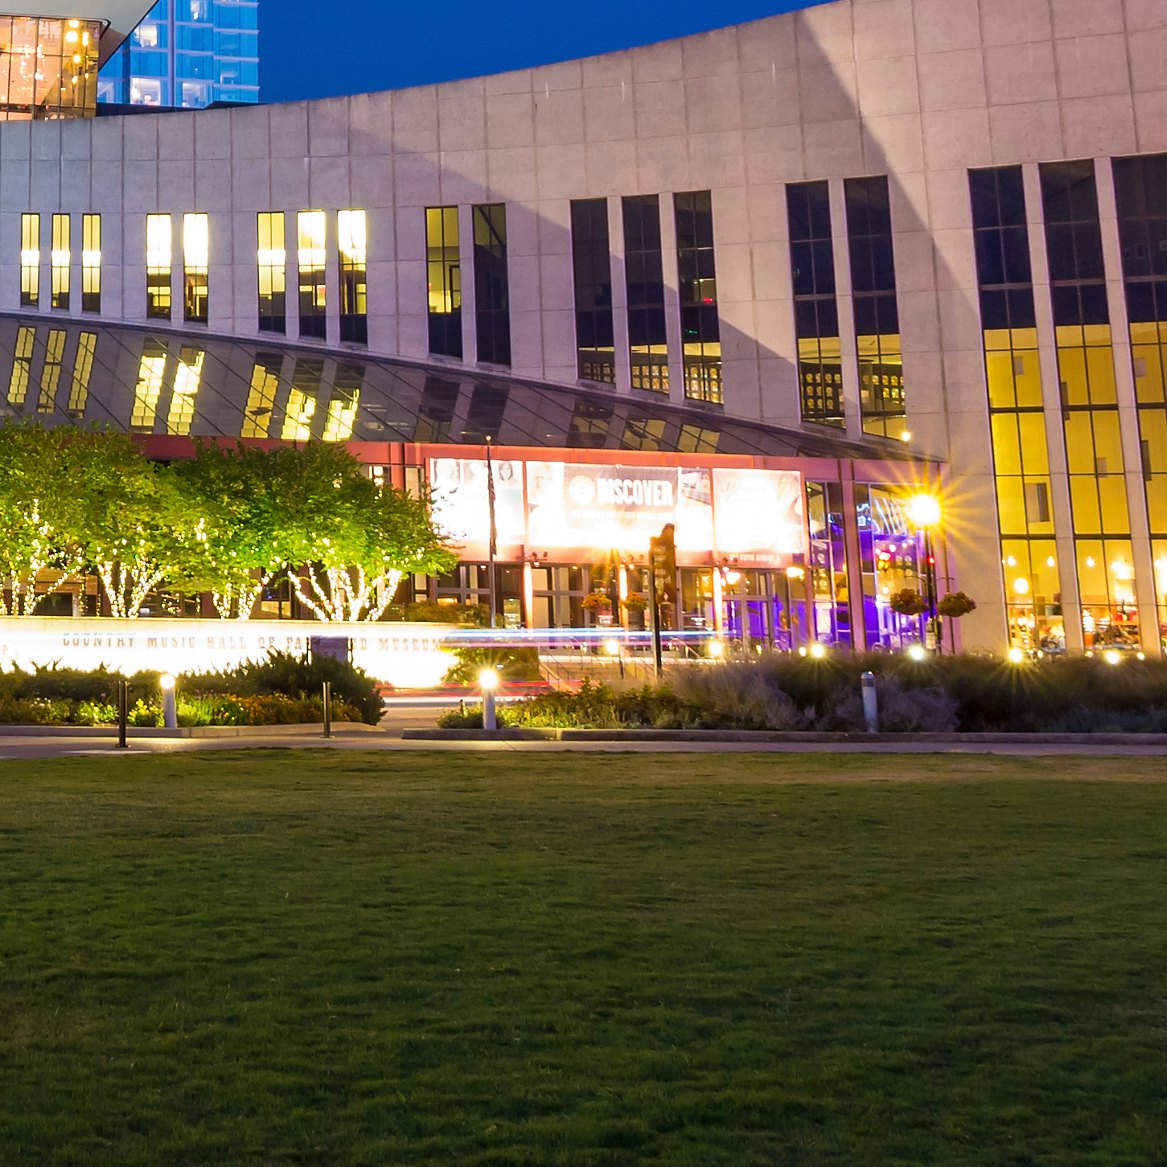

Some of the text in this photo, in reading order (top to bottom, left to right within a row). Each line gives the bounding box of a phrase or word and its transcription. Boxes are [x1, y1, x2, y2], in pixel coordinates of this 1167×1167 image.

[597, 477, 674, 506] DISCOVER
[63, 633, 134, 648] COUNTRY
[147, 635, 196, 649] MUSIC
[207, 636, 246, 649] HALL
[258, 636, 275, 649] OF
